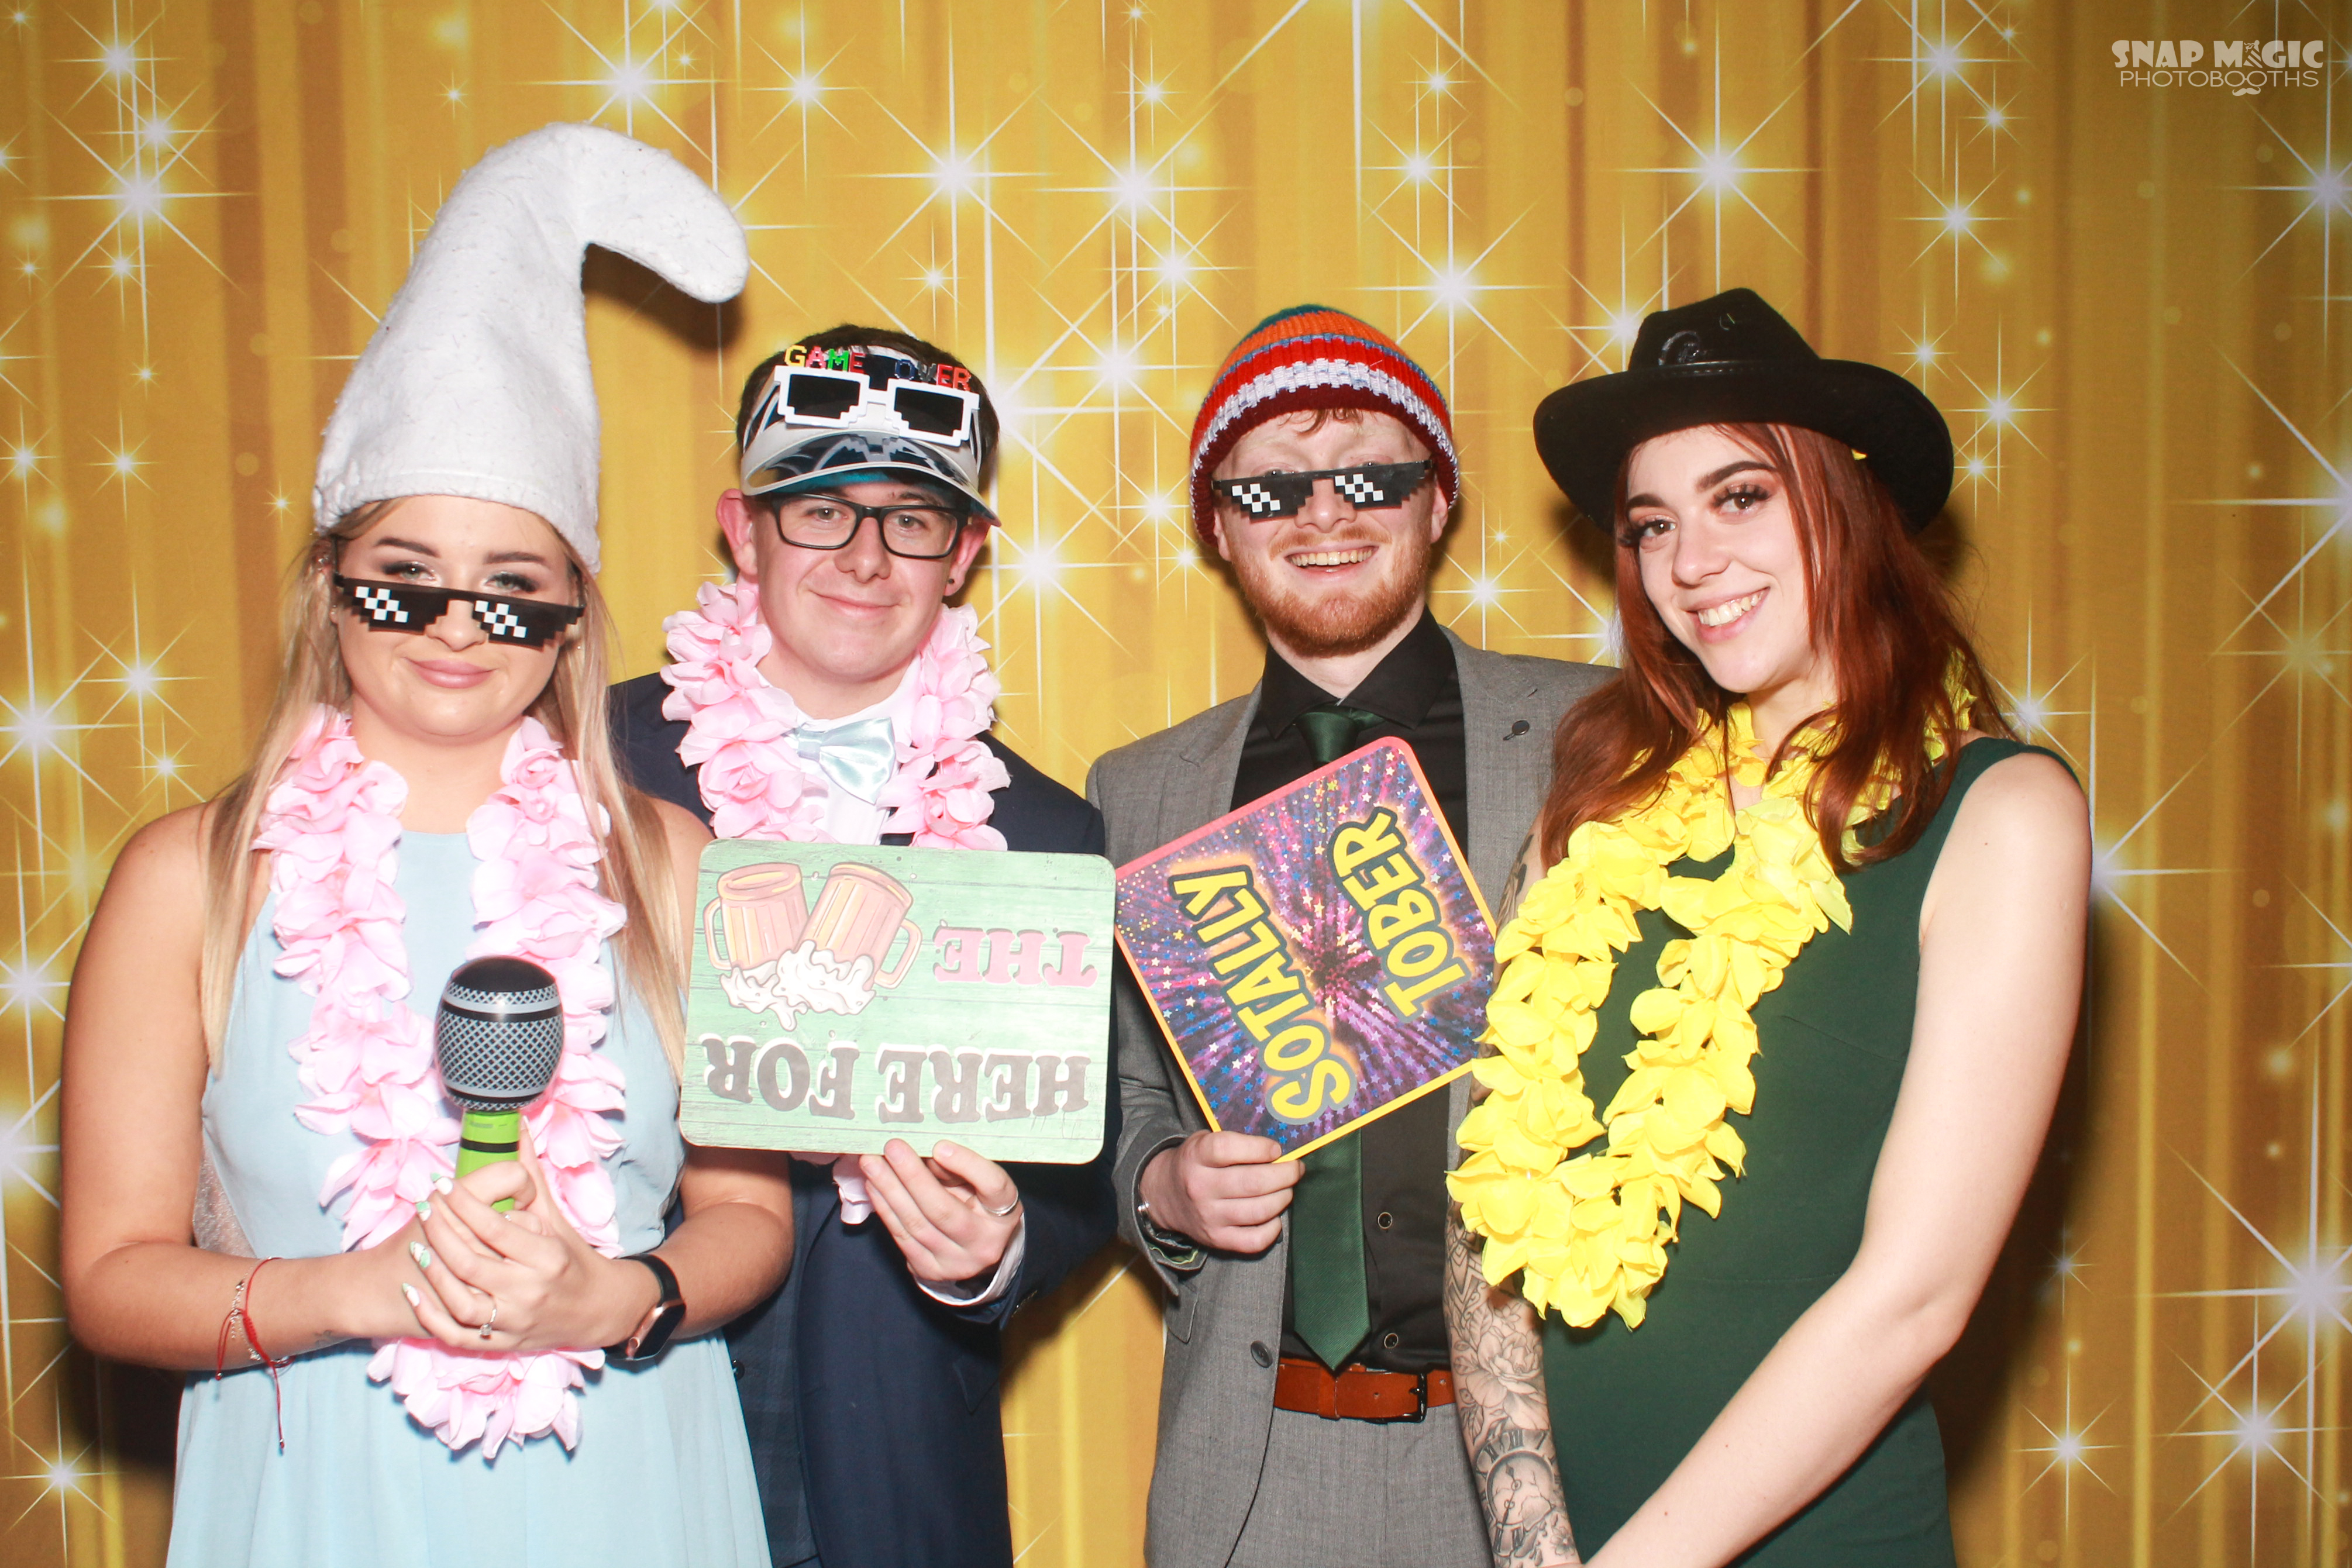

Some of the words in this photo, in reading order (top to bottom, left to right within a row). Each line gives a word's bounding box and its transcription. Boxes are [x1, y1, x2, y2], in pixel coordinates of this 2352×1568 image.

[784, 344, 867, 374] GAME
[894, 359, 972, 391] OVER
[1331, 811, 1468, 1019] TOBER
[933, 926, 1098, 988] THE
[1172, 869, 1352, 1121] SOTALLY
[700, 1034, 860, 1120] FOR
[877, 1043, 1092, 1123] HERE
